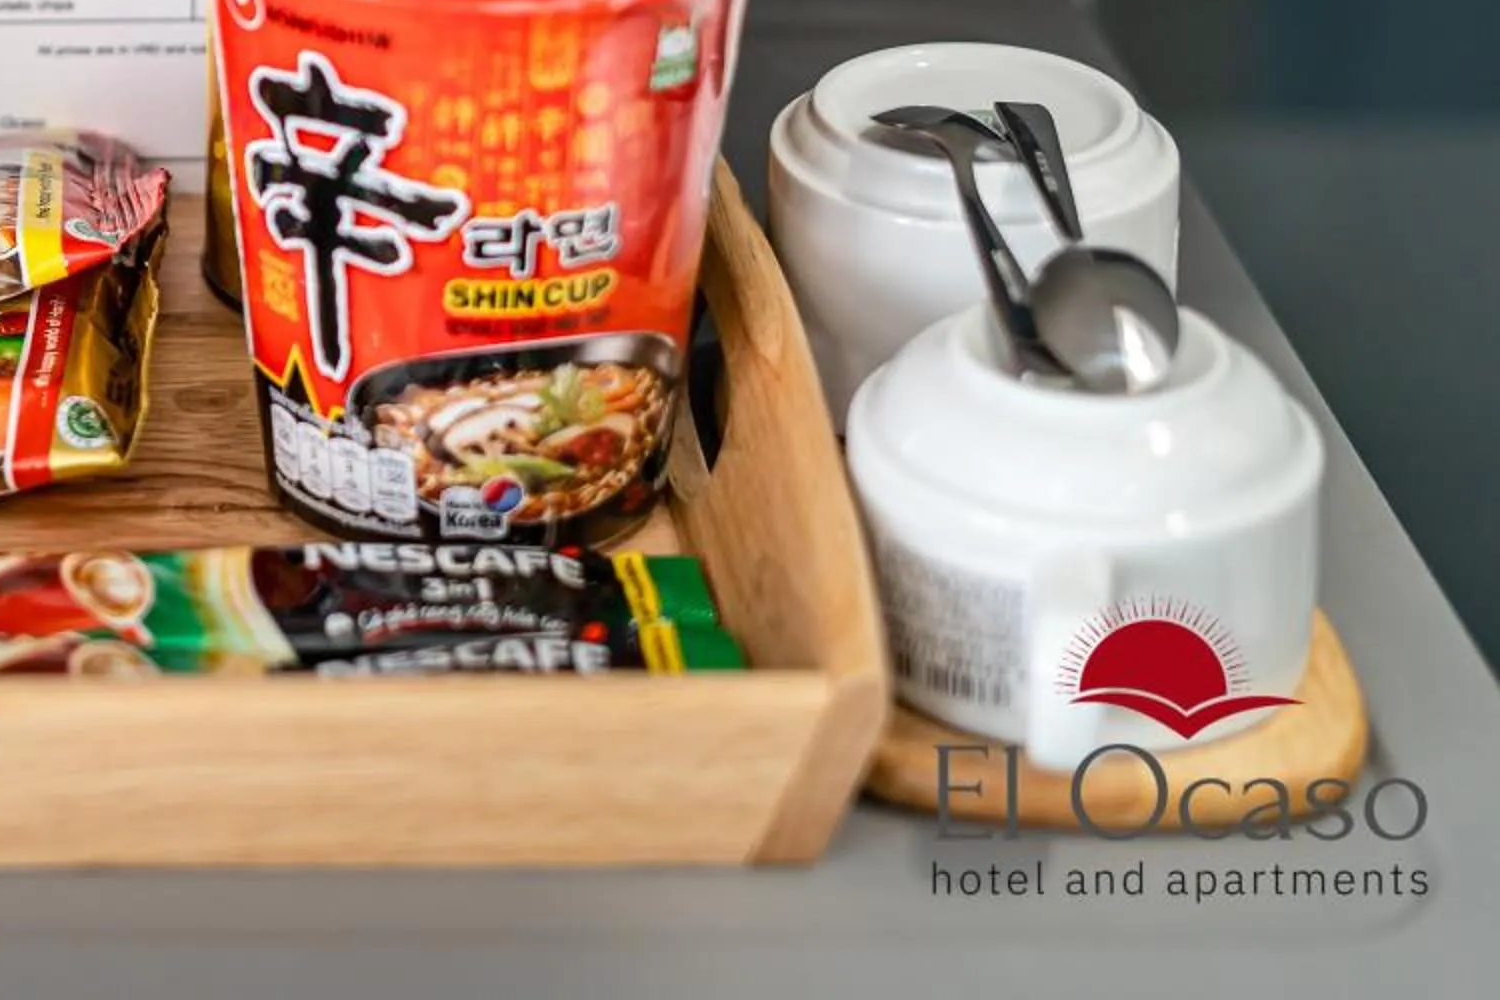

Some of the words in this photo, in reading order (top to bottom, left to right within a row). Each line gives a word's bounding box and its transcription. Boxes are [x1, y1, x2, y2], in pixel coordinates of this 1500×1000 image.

[245, 48, 471, 383] 辛
[460, 200, 621, 280] 라면
[450, 280, 536, 310] SHIN
[542, 272, 612, 308] CUP
[445, 511, 502, 530] Korea
